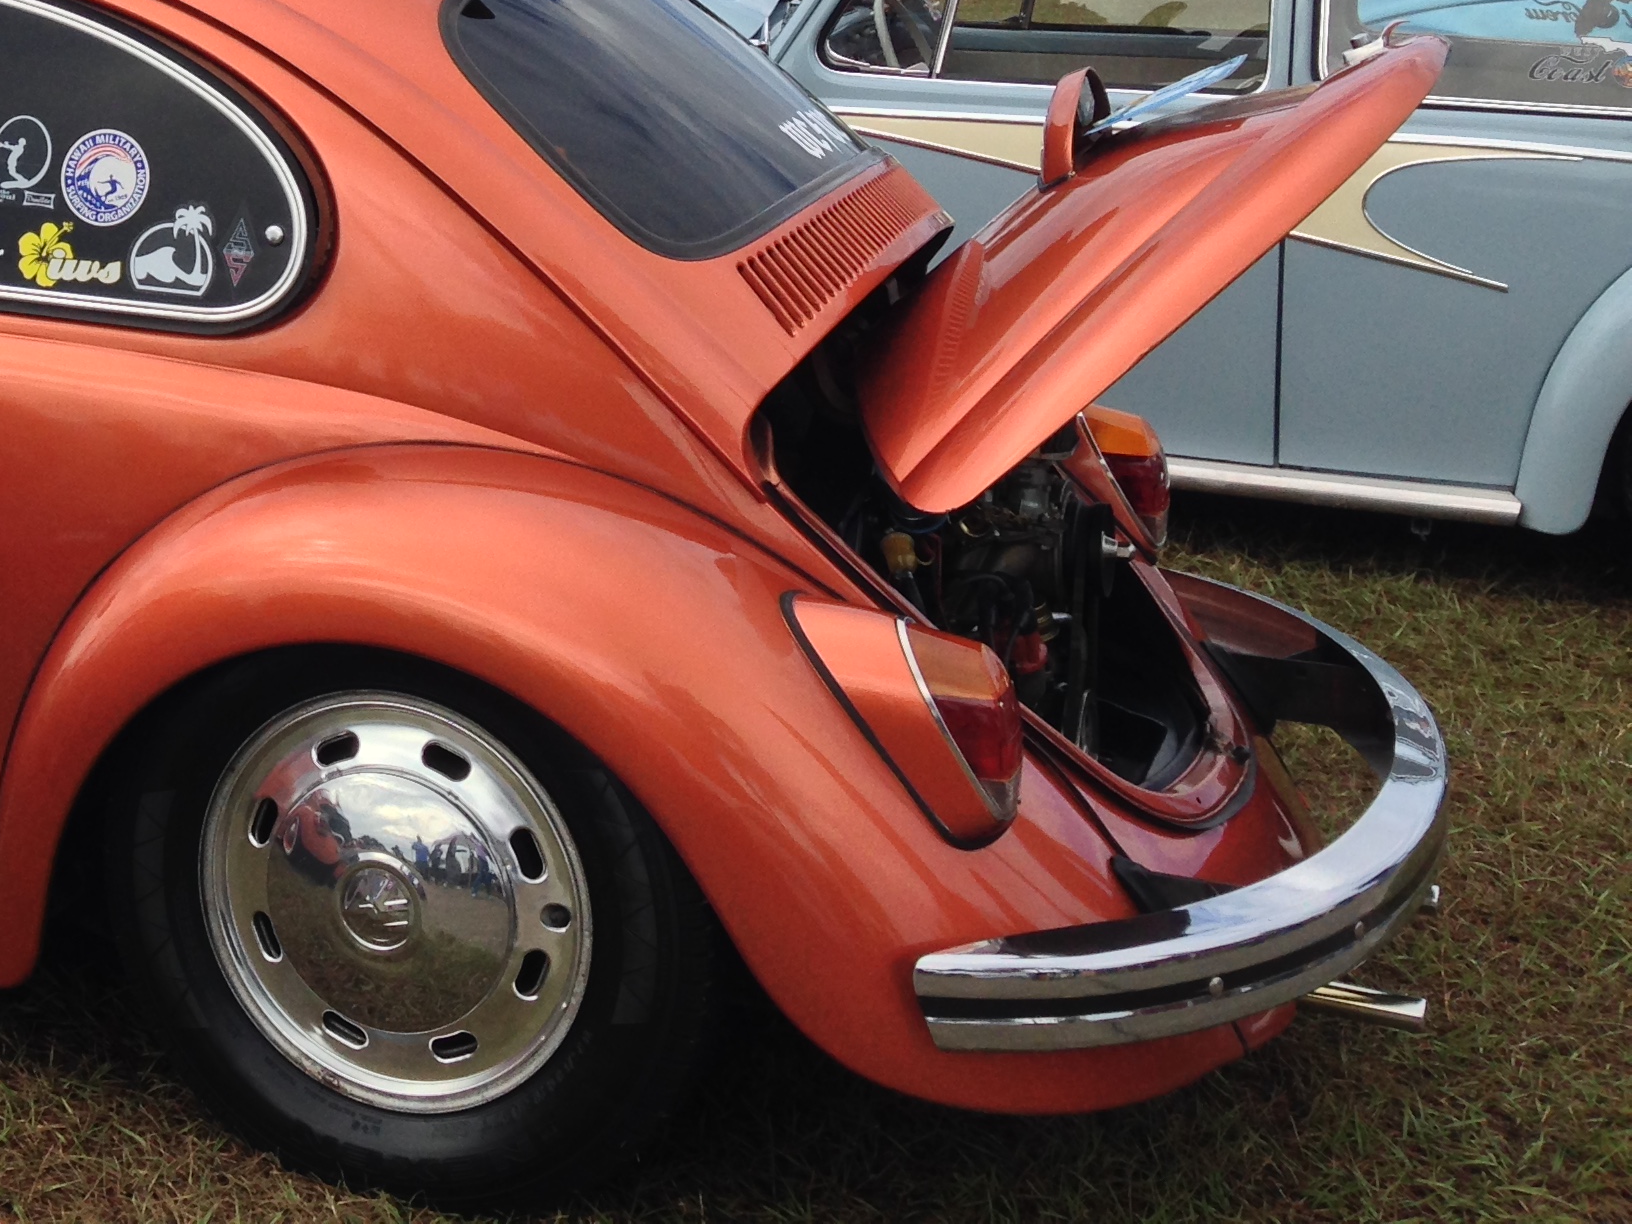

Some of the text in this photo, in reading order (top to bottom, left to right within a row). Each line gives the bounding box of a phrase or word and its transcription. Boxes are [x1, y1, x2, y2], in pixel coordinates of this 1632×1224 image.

[1528, 54, 1613, 84] Coast
[65, 134, 141, 176] HAWAII MILITARY
[66, 169, 146, 222] SURFING ORGANIZATION
